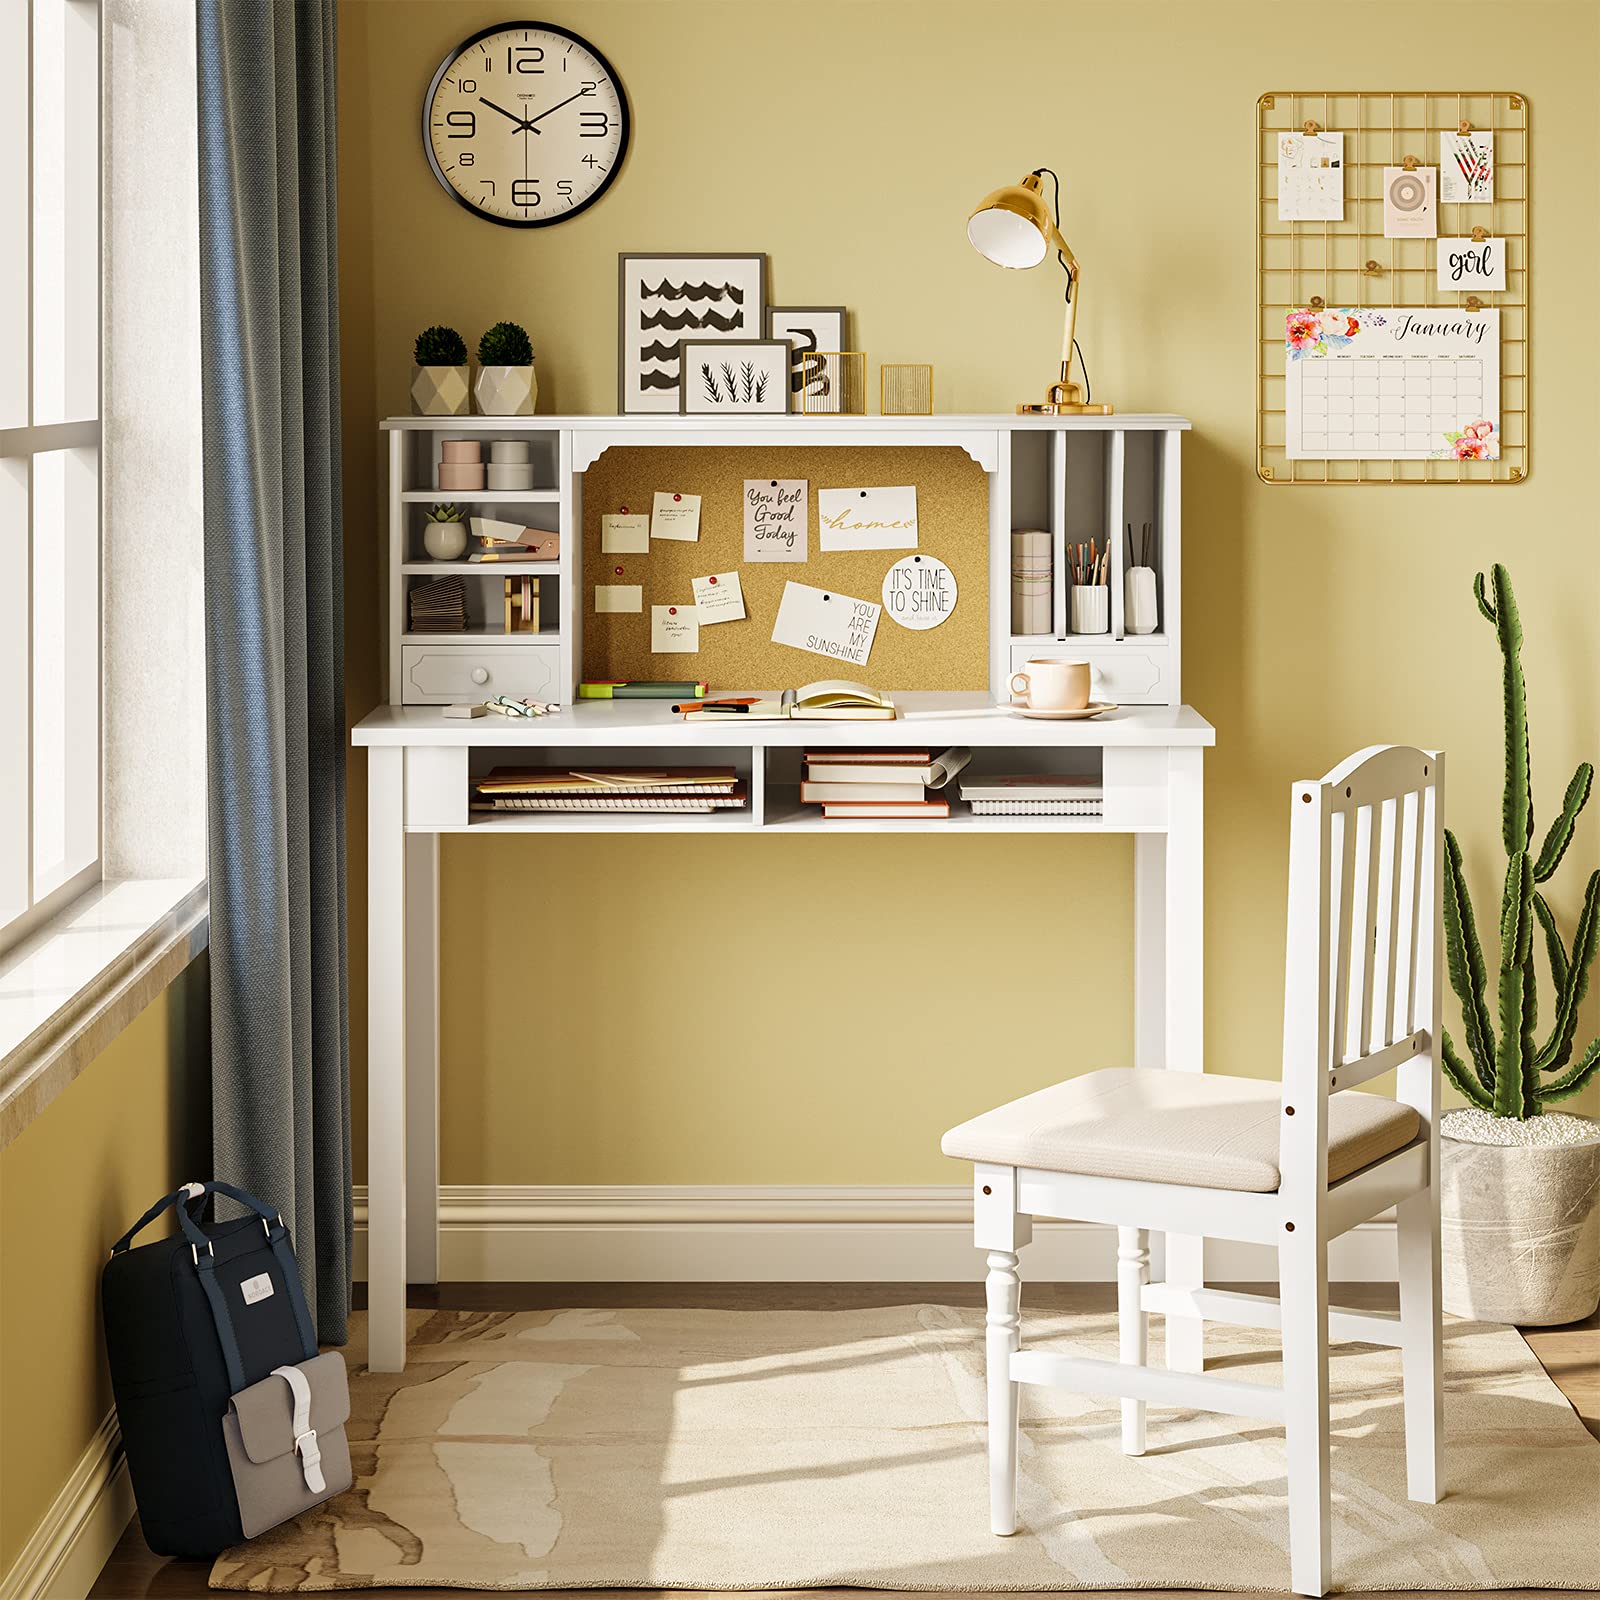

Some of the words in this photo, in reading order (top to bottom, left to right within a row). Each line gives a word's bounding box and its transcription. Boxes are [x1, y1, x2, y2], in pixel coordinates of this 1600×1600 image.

[485, 57, 492, 73] 11
[507, 46, 545, 75] 12
[458, 79, 477, 93] 10
[580, 81, 597, 97] 2
[446, 111, 476, 139] 9
[579, 112, 609, 138] 3
[459, 152, 475, 167] 8
[581, 153, 599, 169] 4
[479, 180, 496, 197] 7
[511, 179, 541, 207] 6
[556, 180, 573, 196] 5
[1449, 245, 1495, 281] girl
[1390, 314, 1491, 344] January
[746, 488, 774, 506] You
[777, 488, 802, 506] feel
[754, 504, 795, 522] Good
[829, 508, 904, 530] home
[754, 524, 798, 547] Today
[892, 568, 912, 590] IT'S
[918, 568, 946, 590] TIME
[853, 602, 875, 618] YOU
[889, 590, 906, 612] TO
[911, 590, 949, 612] SHINE
[848, 617, 872, 634] ARE
[806, 634, 864, 662] SUNSHINE
[849, 632, 868, 648] MY
